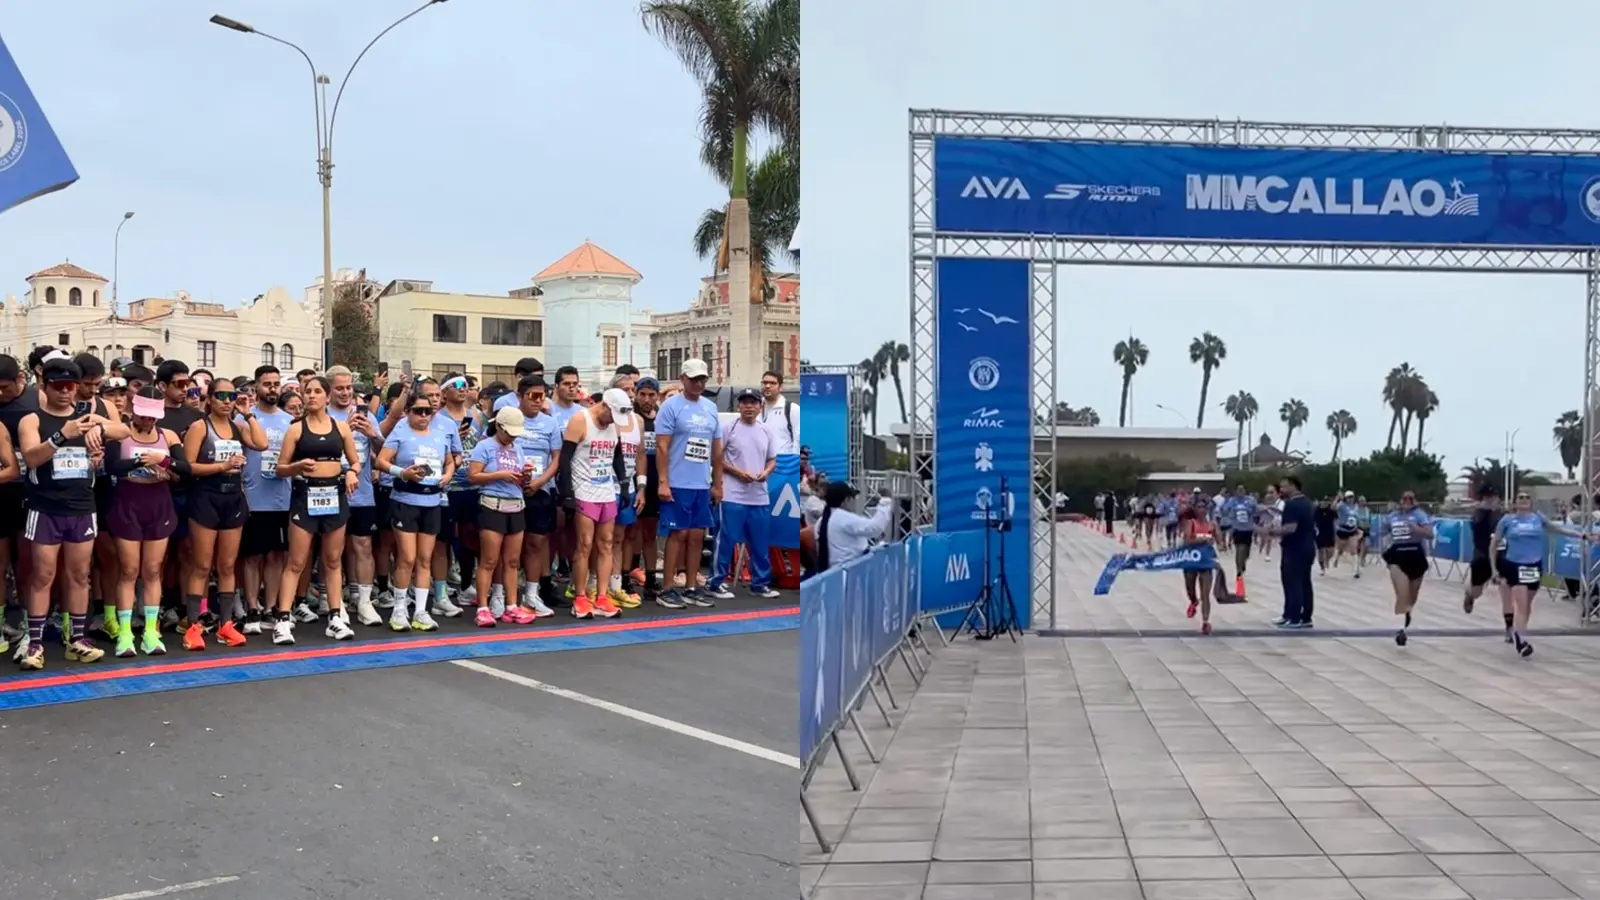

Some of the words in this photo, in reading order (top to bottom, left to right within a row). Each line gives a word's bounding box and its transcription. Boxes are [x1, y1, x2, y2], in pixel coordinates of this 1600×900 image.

[960, 176, 1031, 199] AVA
[1087, 184, 1161, 196] SKECHERS
[1186, 174, 1445, 217] MMCALLAO
[963, 418, 1005, 429] RIMAC
[590, 440, 616, 450] PERU
[312, 498, 332, 507] 1183
[772, 483, 800, 518] A
[945, 553, 971, 583] AVA
